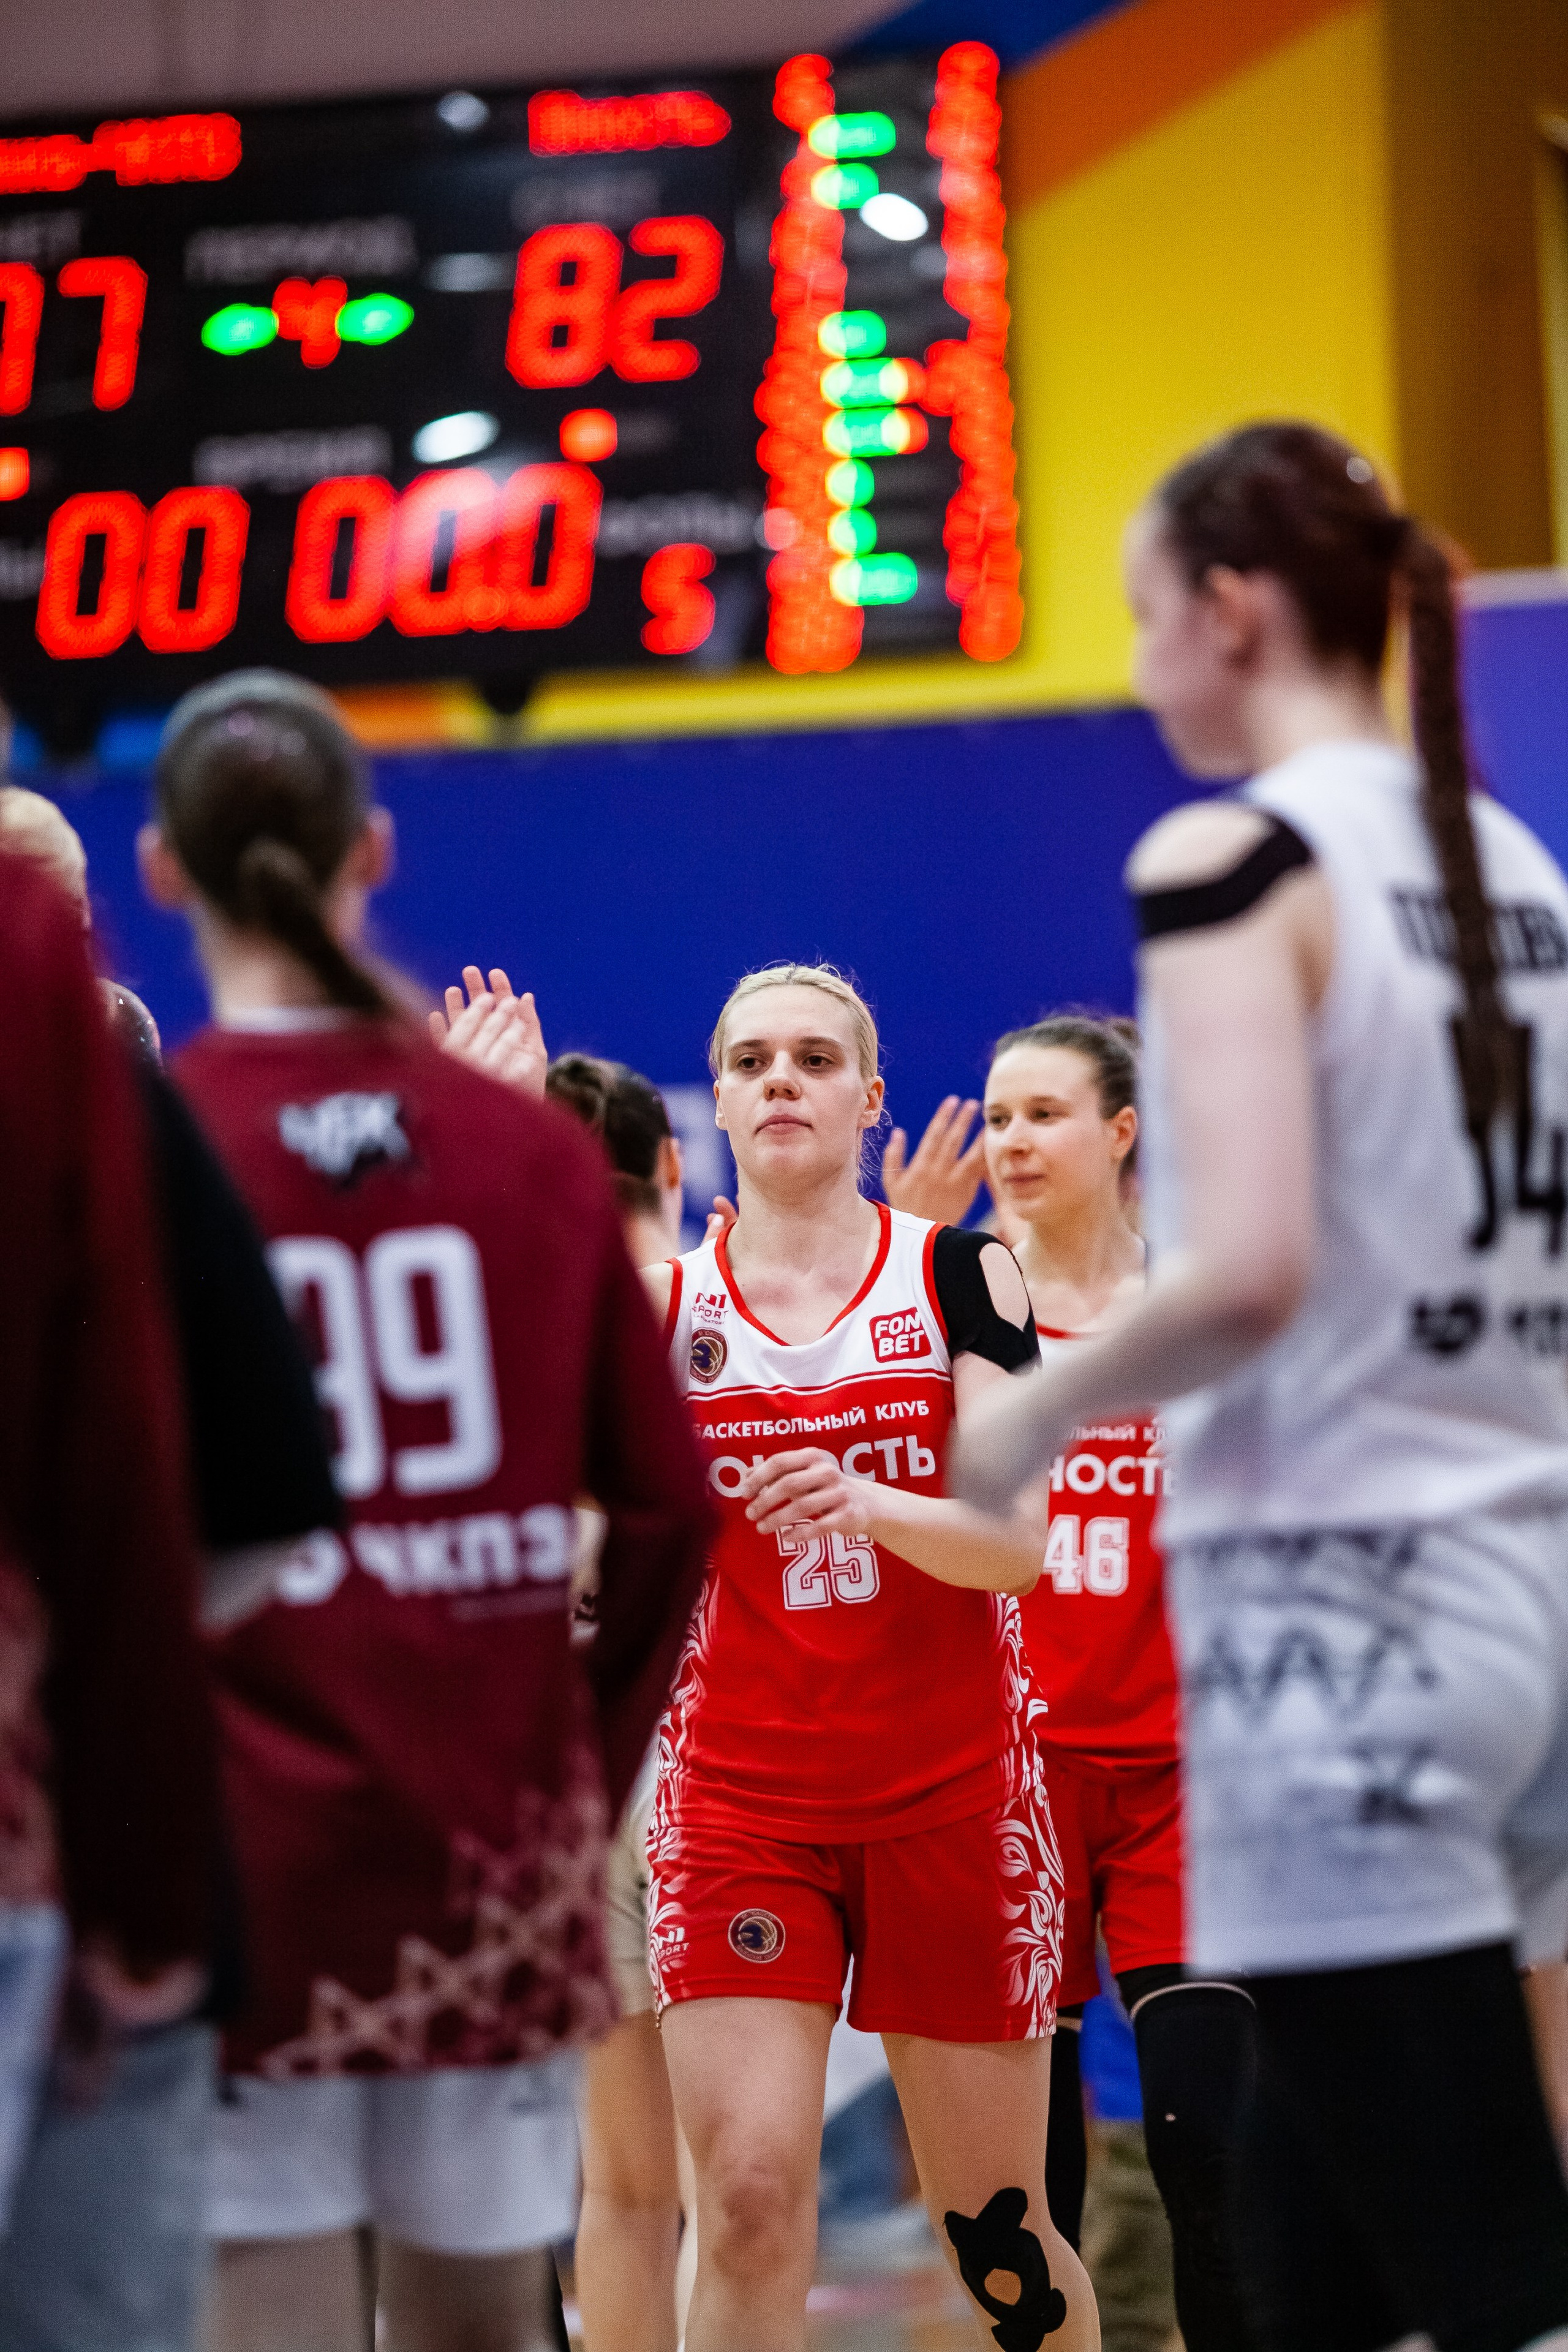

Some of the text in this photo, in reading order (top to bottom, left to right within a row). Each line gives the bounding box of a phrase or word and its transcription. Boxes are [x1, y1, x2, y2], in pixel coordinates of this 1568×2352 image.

[272, 277, 347, 368] 4
[506, 216, 724, 388] 82
[36, 485, 250, 660] 00
[695, 1292, 727, 1308] N1
[875, 1311, 921, 1338] FON
[878, 1330, 925, 1357] BET
[875, 1400, 929, 1421] КЛУБ
[776, 1518, 880, 1610] 25
[1041, 1514, 1129, 1597] 46
